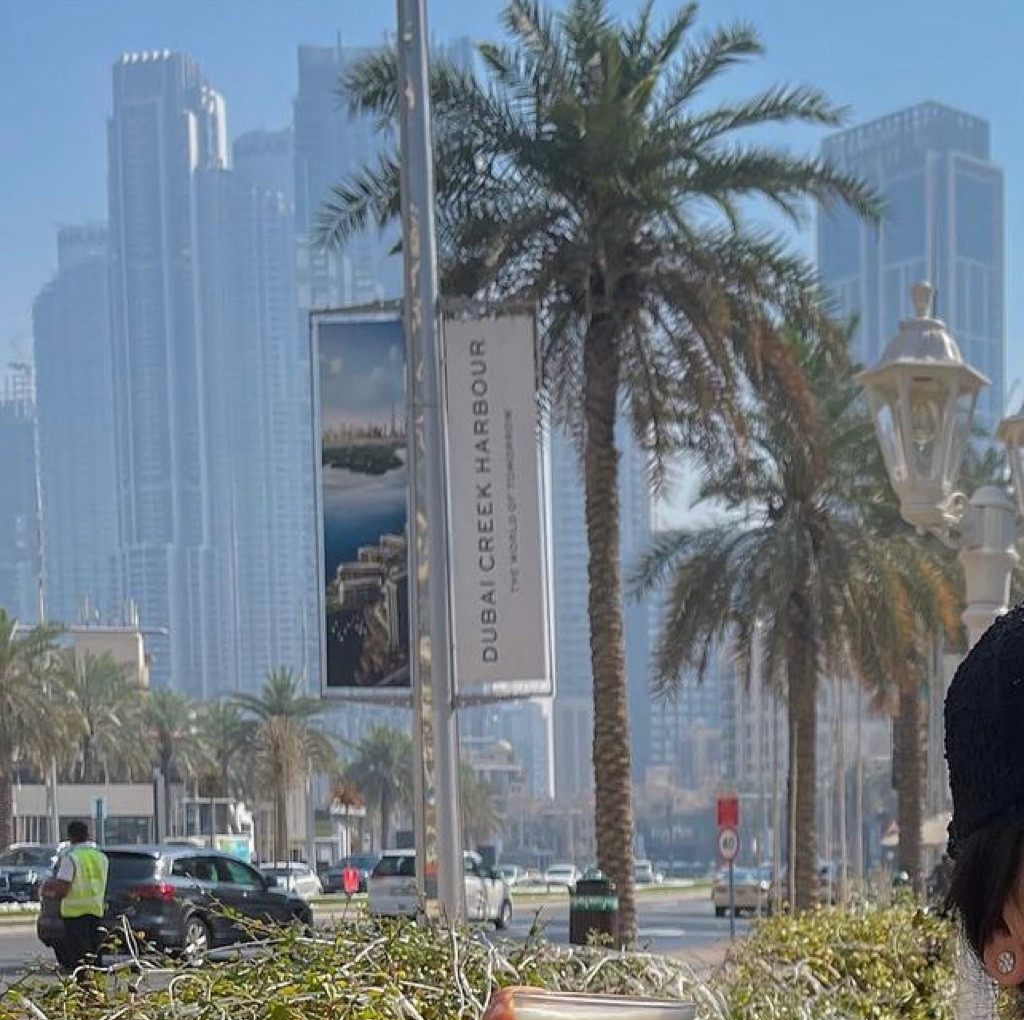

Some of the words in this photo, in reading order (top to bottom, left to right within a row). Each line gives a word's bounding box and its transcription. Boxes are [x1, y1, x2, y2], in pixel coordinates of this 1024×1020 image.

[470, 340, 491, 473] HARBOUR
[477, 483, 495, 572] CREEK
[507, 494, 517, 512] OF
[508, 515, 519, 563] WORLD
[510, 569, 519, 592] THE
[481, 582, 498, 663] DUBAI
